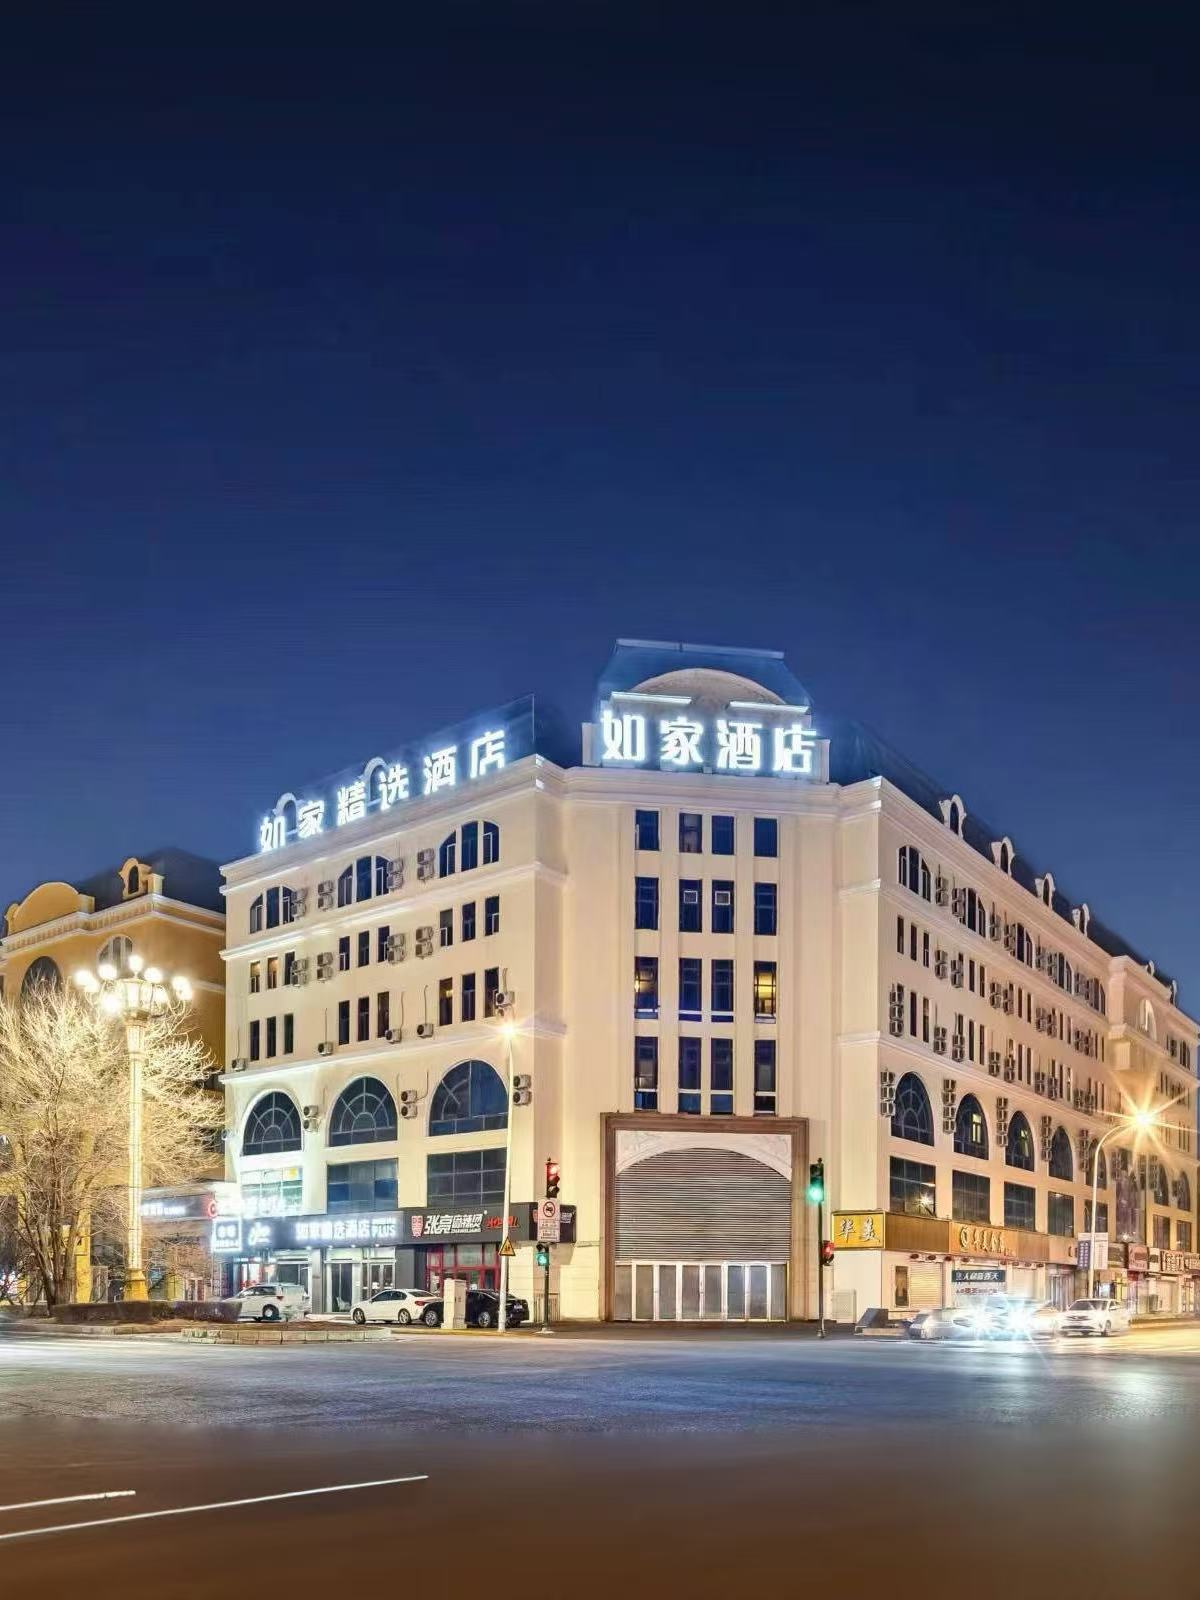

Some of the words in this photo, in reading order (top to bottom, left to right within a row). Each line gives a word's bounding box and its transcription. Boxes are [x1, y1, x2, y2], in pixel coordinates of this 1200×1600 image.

[601, 710, 817, 773] 如家酒店
[260, 730, 505, 853] 如家精选酒店
